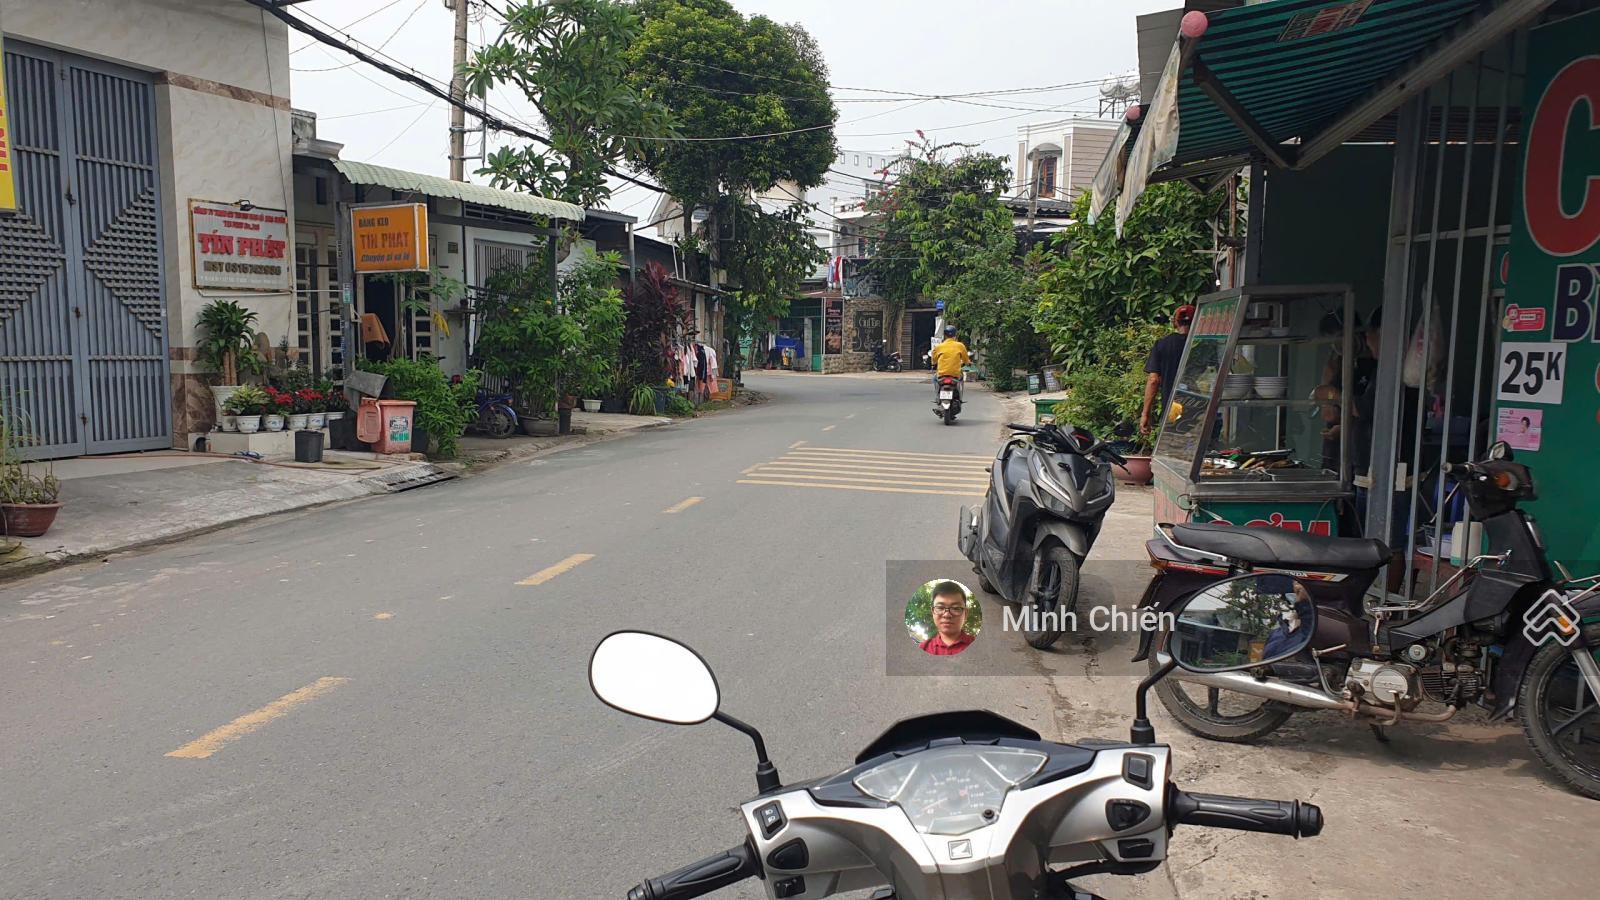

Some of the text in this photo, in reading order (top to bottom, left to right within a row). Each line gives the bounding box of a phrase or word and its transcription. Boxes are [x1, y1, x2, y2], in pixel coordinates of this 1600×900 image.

[198, 229, 286, 258] TÍN PHÁT
[1551, 263, 1600, 343] B
[1501, 350, 1563, 395] 25K
